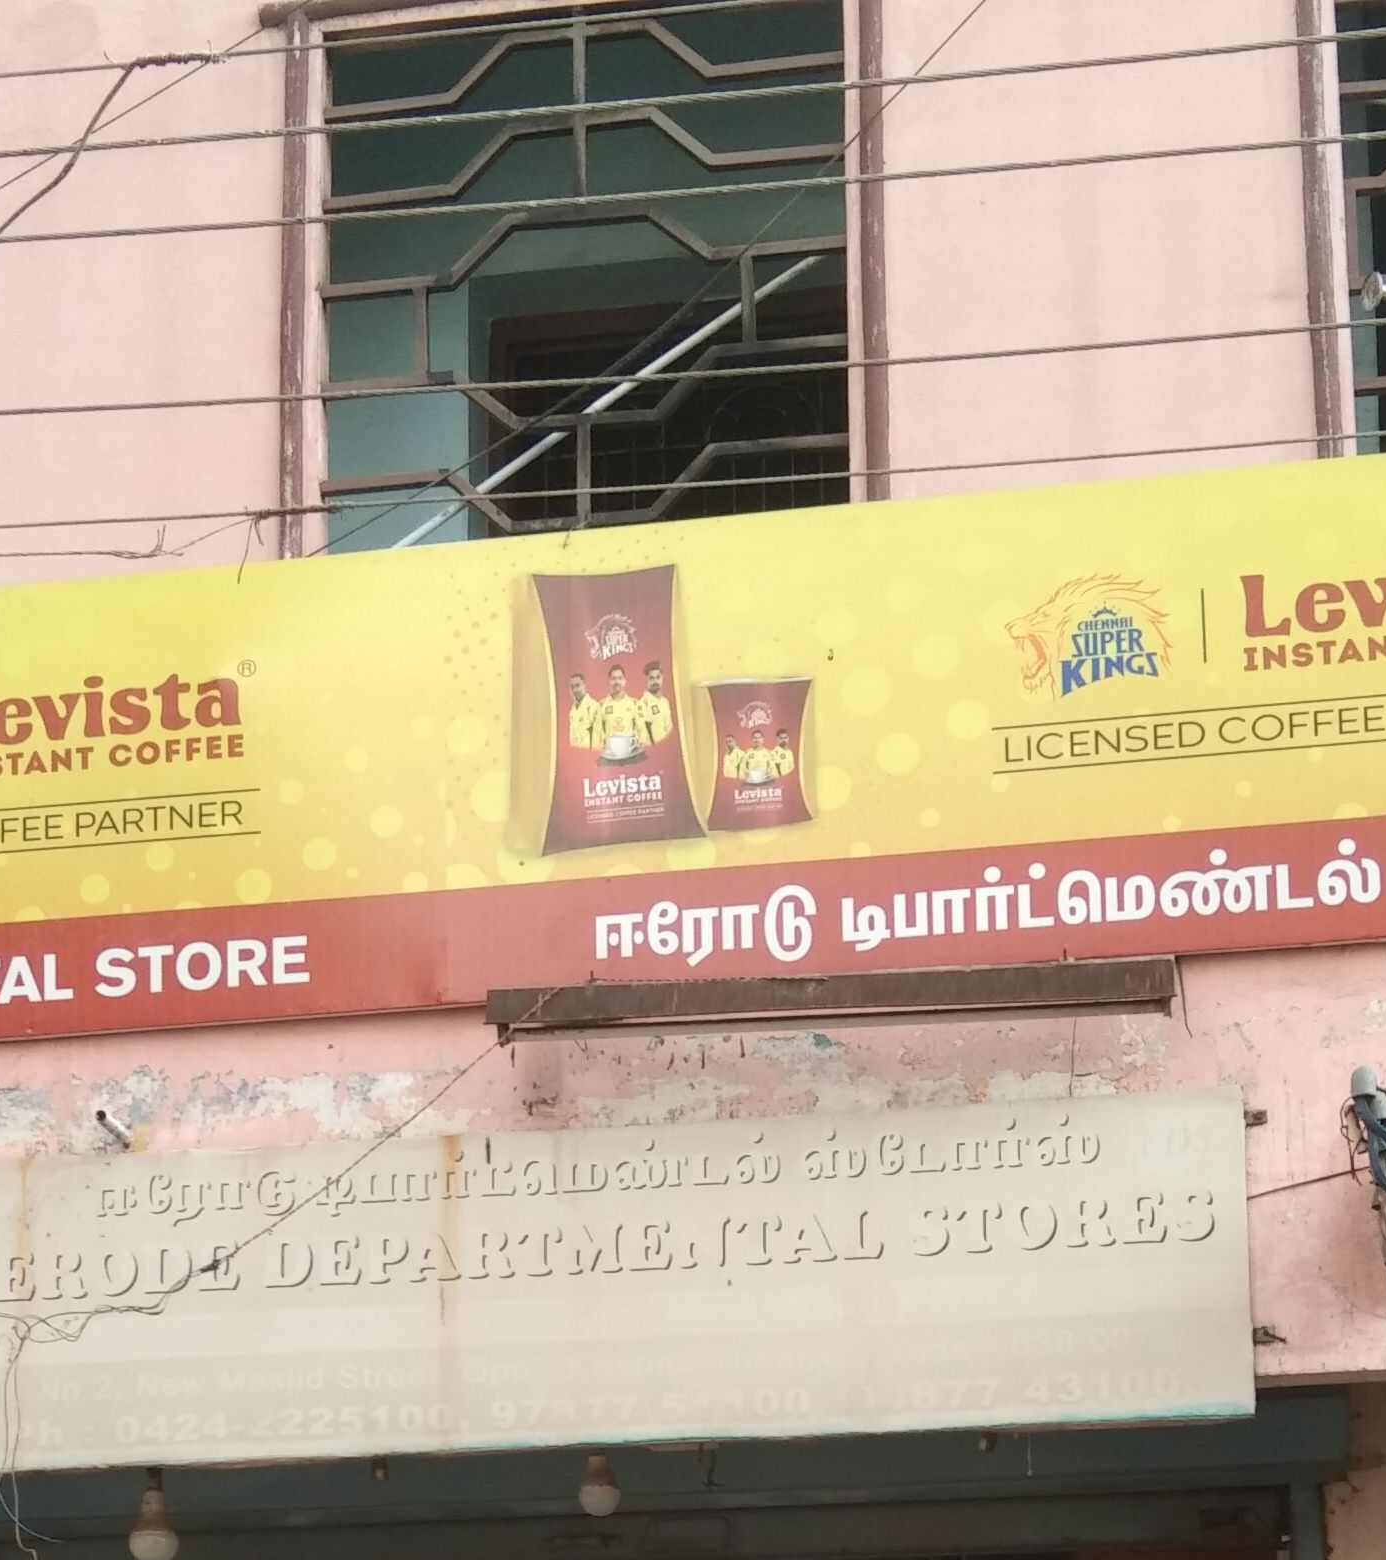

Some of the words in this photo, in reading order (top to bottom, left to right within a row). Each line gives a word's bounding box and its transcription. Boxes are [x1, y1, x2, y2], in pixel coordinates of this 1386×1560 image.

[1071, 629, 1144, 659] SUPER
[1077, 616, 1133, 632] CHENNAI
[1060, 651, 1159, 698] KINGS
[109, 735, 244, 768] COFFEE
[1004, 722, 1206, 763] LICENSED
[1219, 702, 1385, 743] COFFEE
[583, 774, 661, 797] Levista
[75, 800, 243, 838] PARTNER
[594, 884, 818, 966] ஈரோடு
[841, 839, 1380, 946] டிபார்ட்மெண்டல்
[94, 934, 310, 994] STORE
[913, 1191, 1215, 1257] STORES
